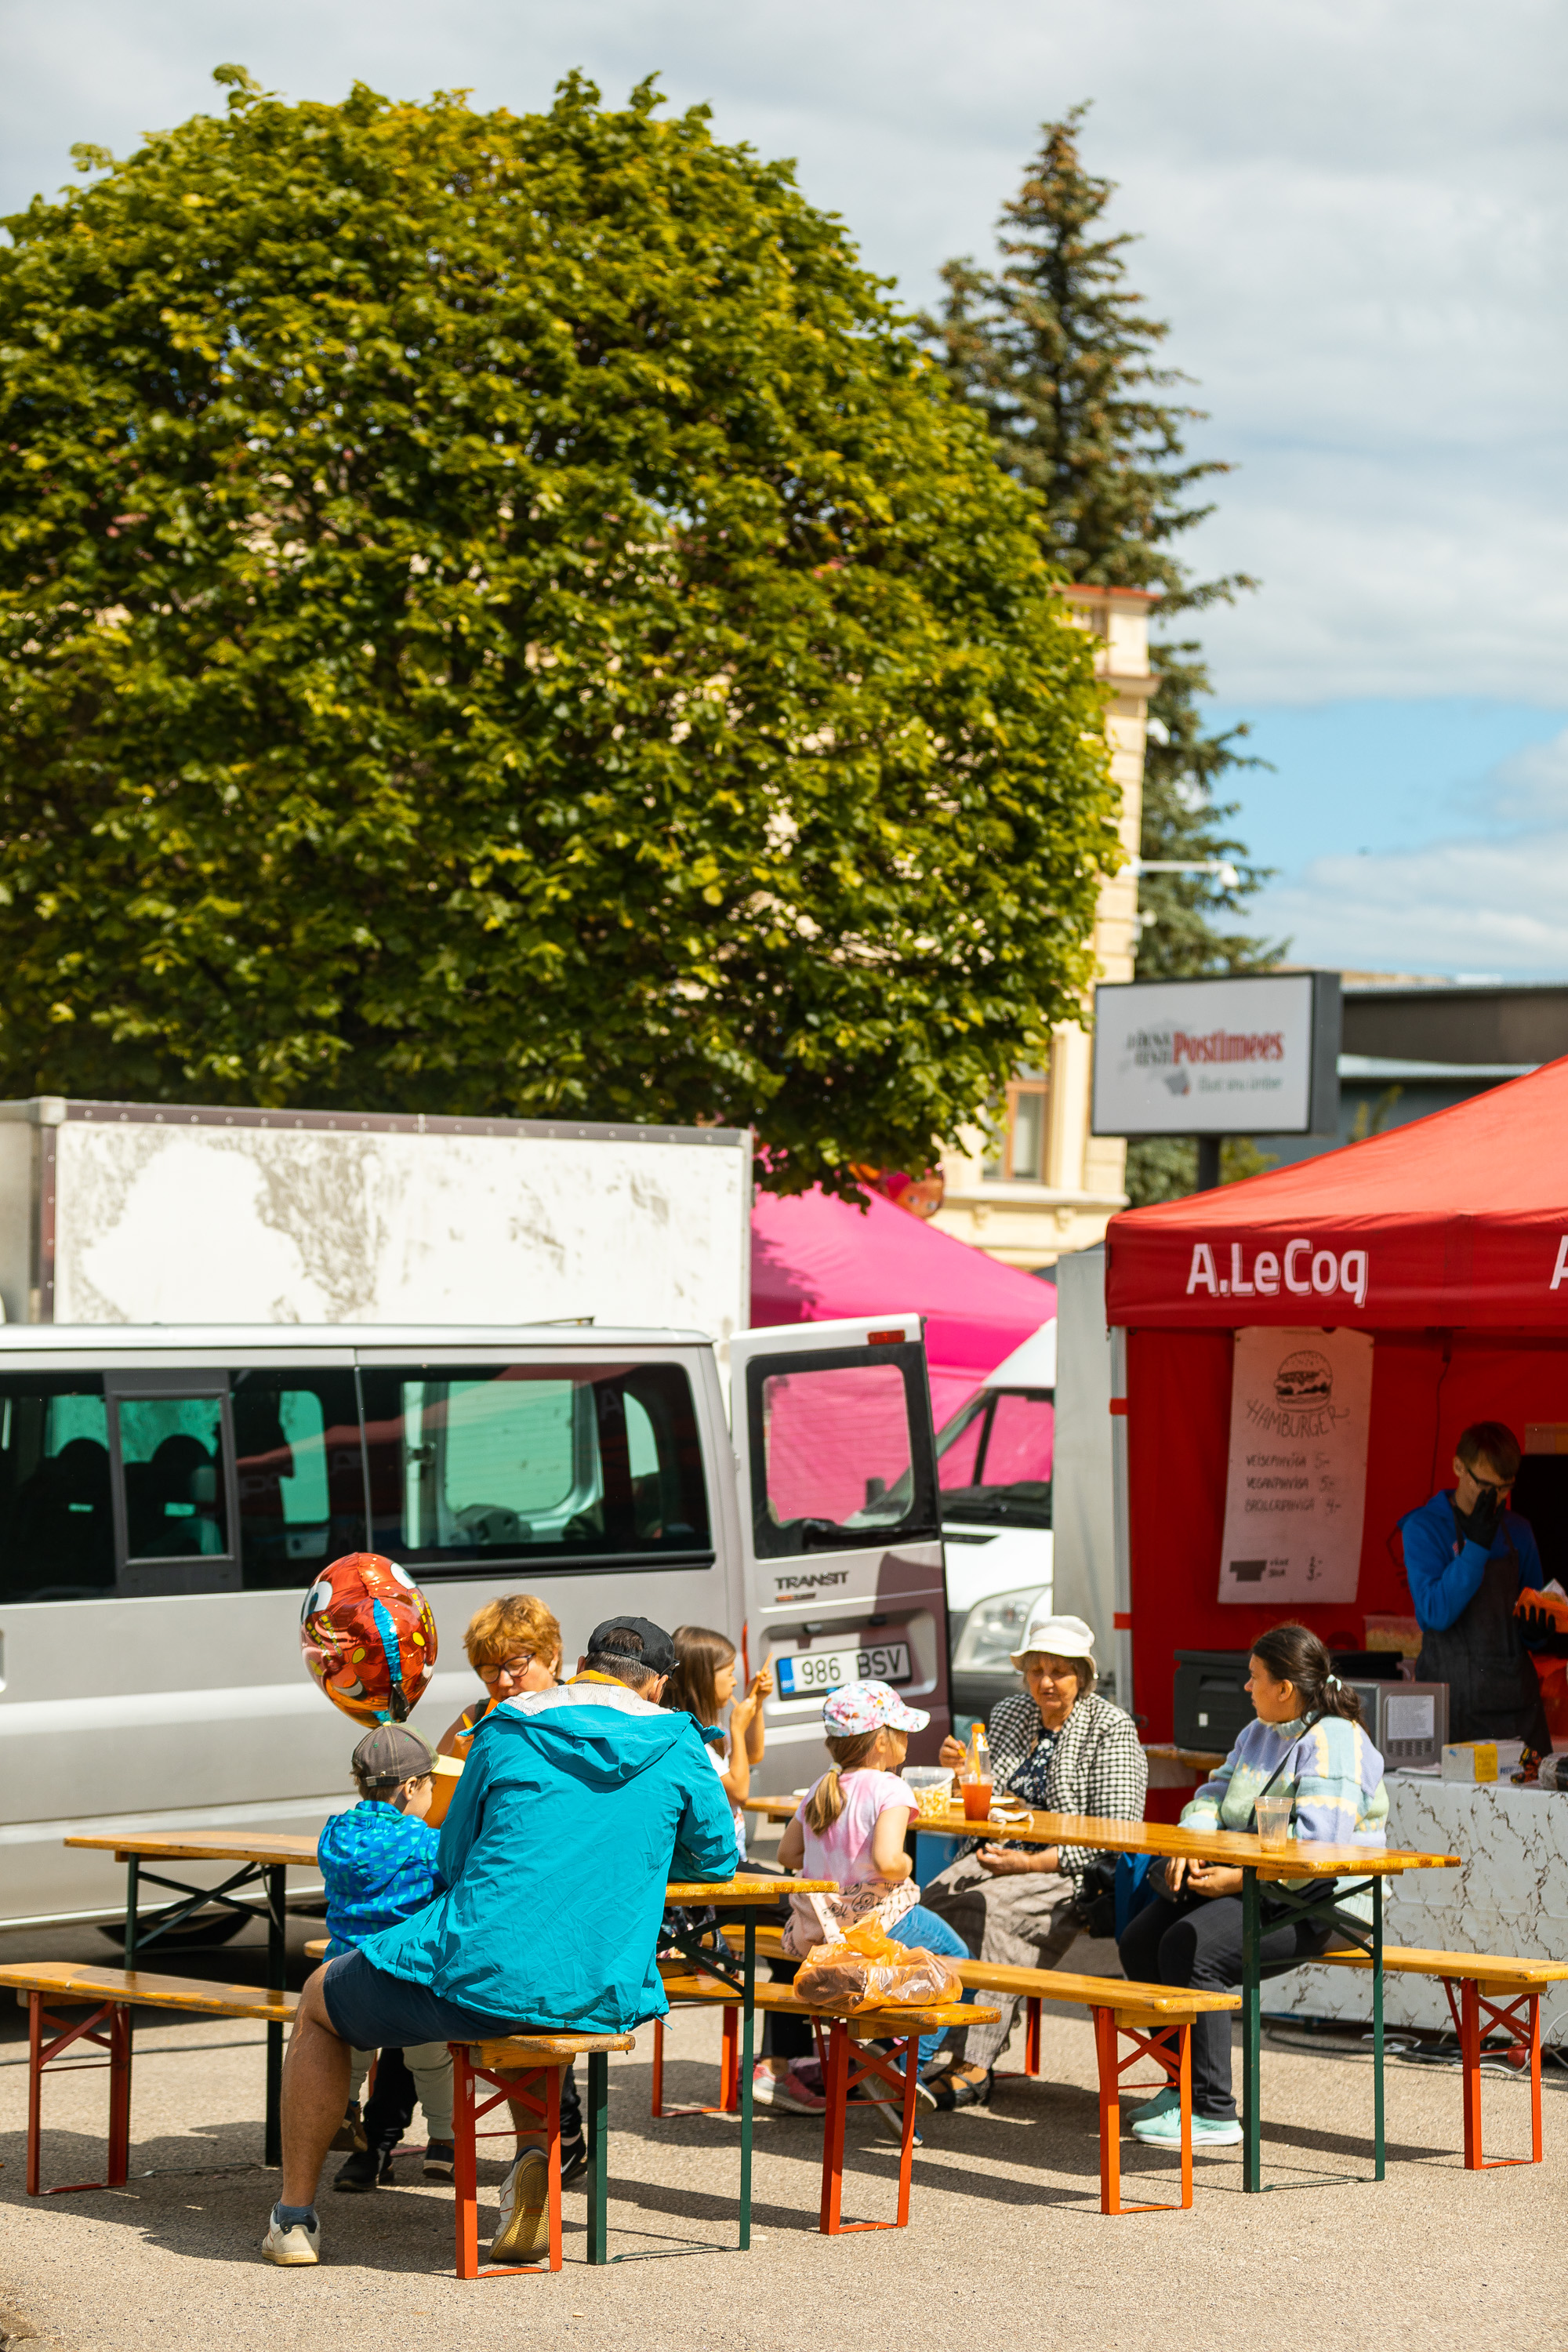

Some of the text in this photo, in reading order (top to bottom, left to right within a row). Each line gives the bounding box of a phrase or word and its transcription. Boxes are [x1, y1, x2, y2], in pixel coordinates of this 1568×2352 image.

[1173, 1029, 1285, 1065] Postimees
[1245, 1399, 1350, 1439] HAMBURGER
[775, 1571, 848, 1589] TRANSIT
[802, 1648, 901, 1685] 986 BSV
